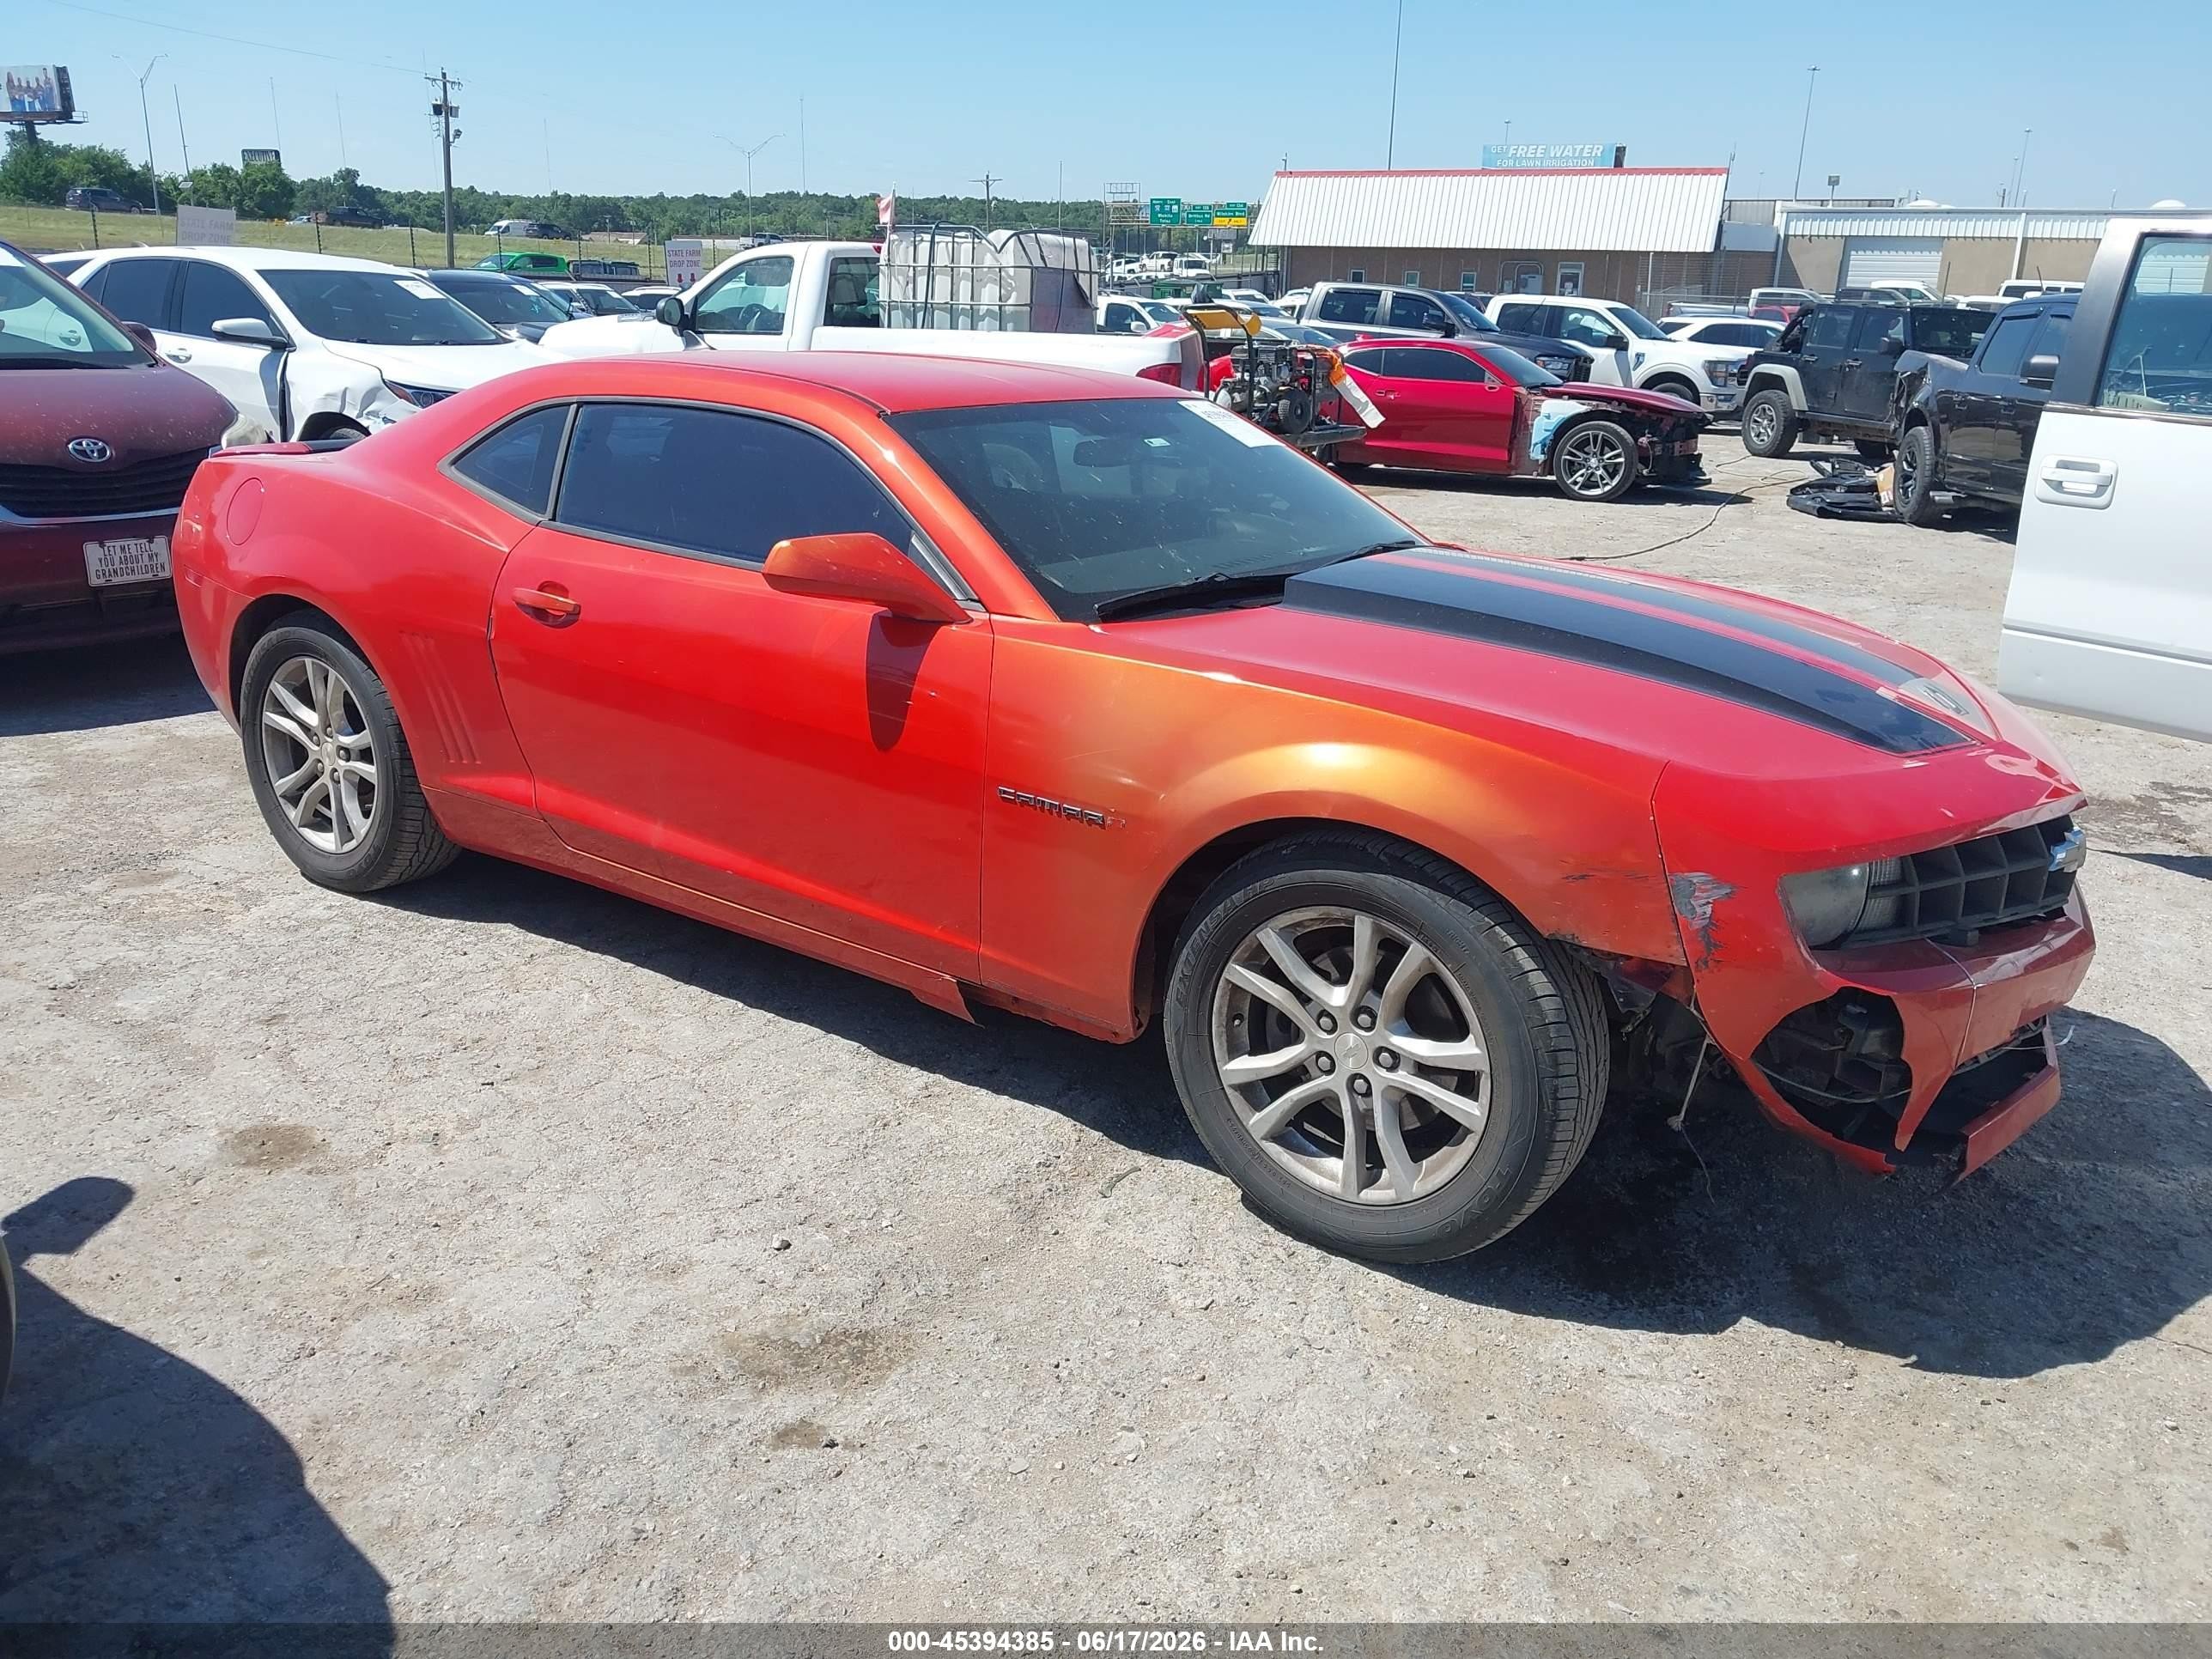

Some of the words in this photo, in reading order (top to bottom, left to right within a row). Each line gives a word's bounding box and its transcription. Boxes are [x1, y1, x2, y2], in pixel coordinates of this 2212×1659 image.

[1509, 144, 1547, 158] FREE
[1549, 143, 1603, 157] WATER
[1497, 159, 1513, 167] FOR
[1516, 159, 1541, 167] LAWN
[1544, 158, 1595, 167] IRRIGATION
[180, 219, 205, 228] STATE
[209, 220, 234, 232] FARM
[182, 231, 206, 241] DROP
[208, 233, 232, 244] ZONE
[670, 259, 685, 268] DROP
[686, 259, 701, 268] ZONE
[102, 545, 117, 556] LET
[119, 544, 132, 555] ME
[134, 542, 154, 553] TELL
[98, 556, 115, 568] YOU
[118, 554, 144, 566] ABOUT
[148, 552, 159, 562] MY
[95, 562, 166, 580] GRANDCHILDREN
[1436, 1164, 1512, 1238] TOYO
